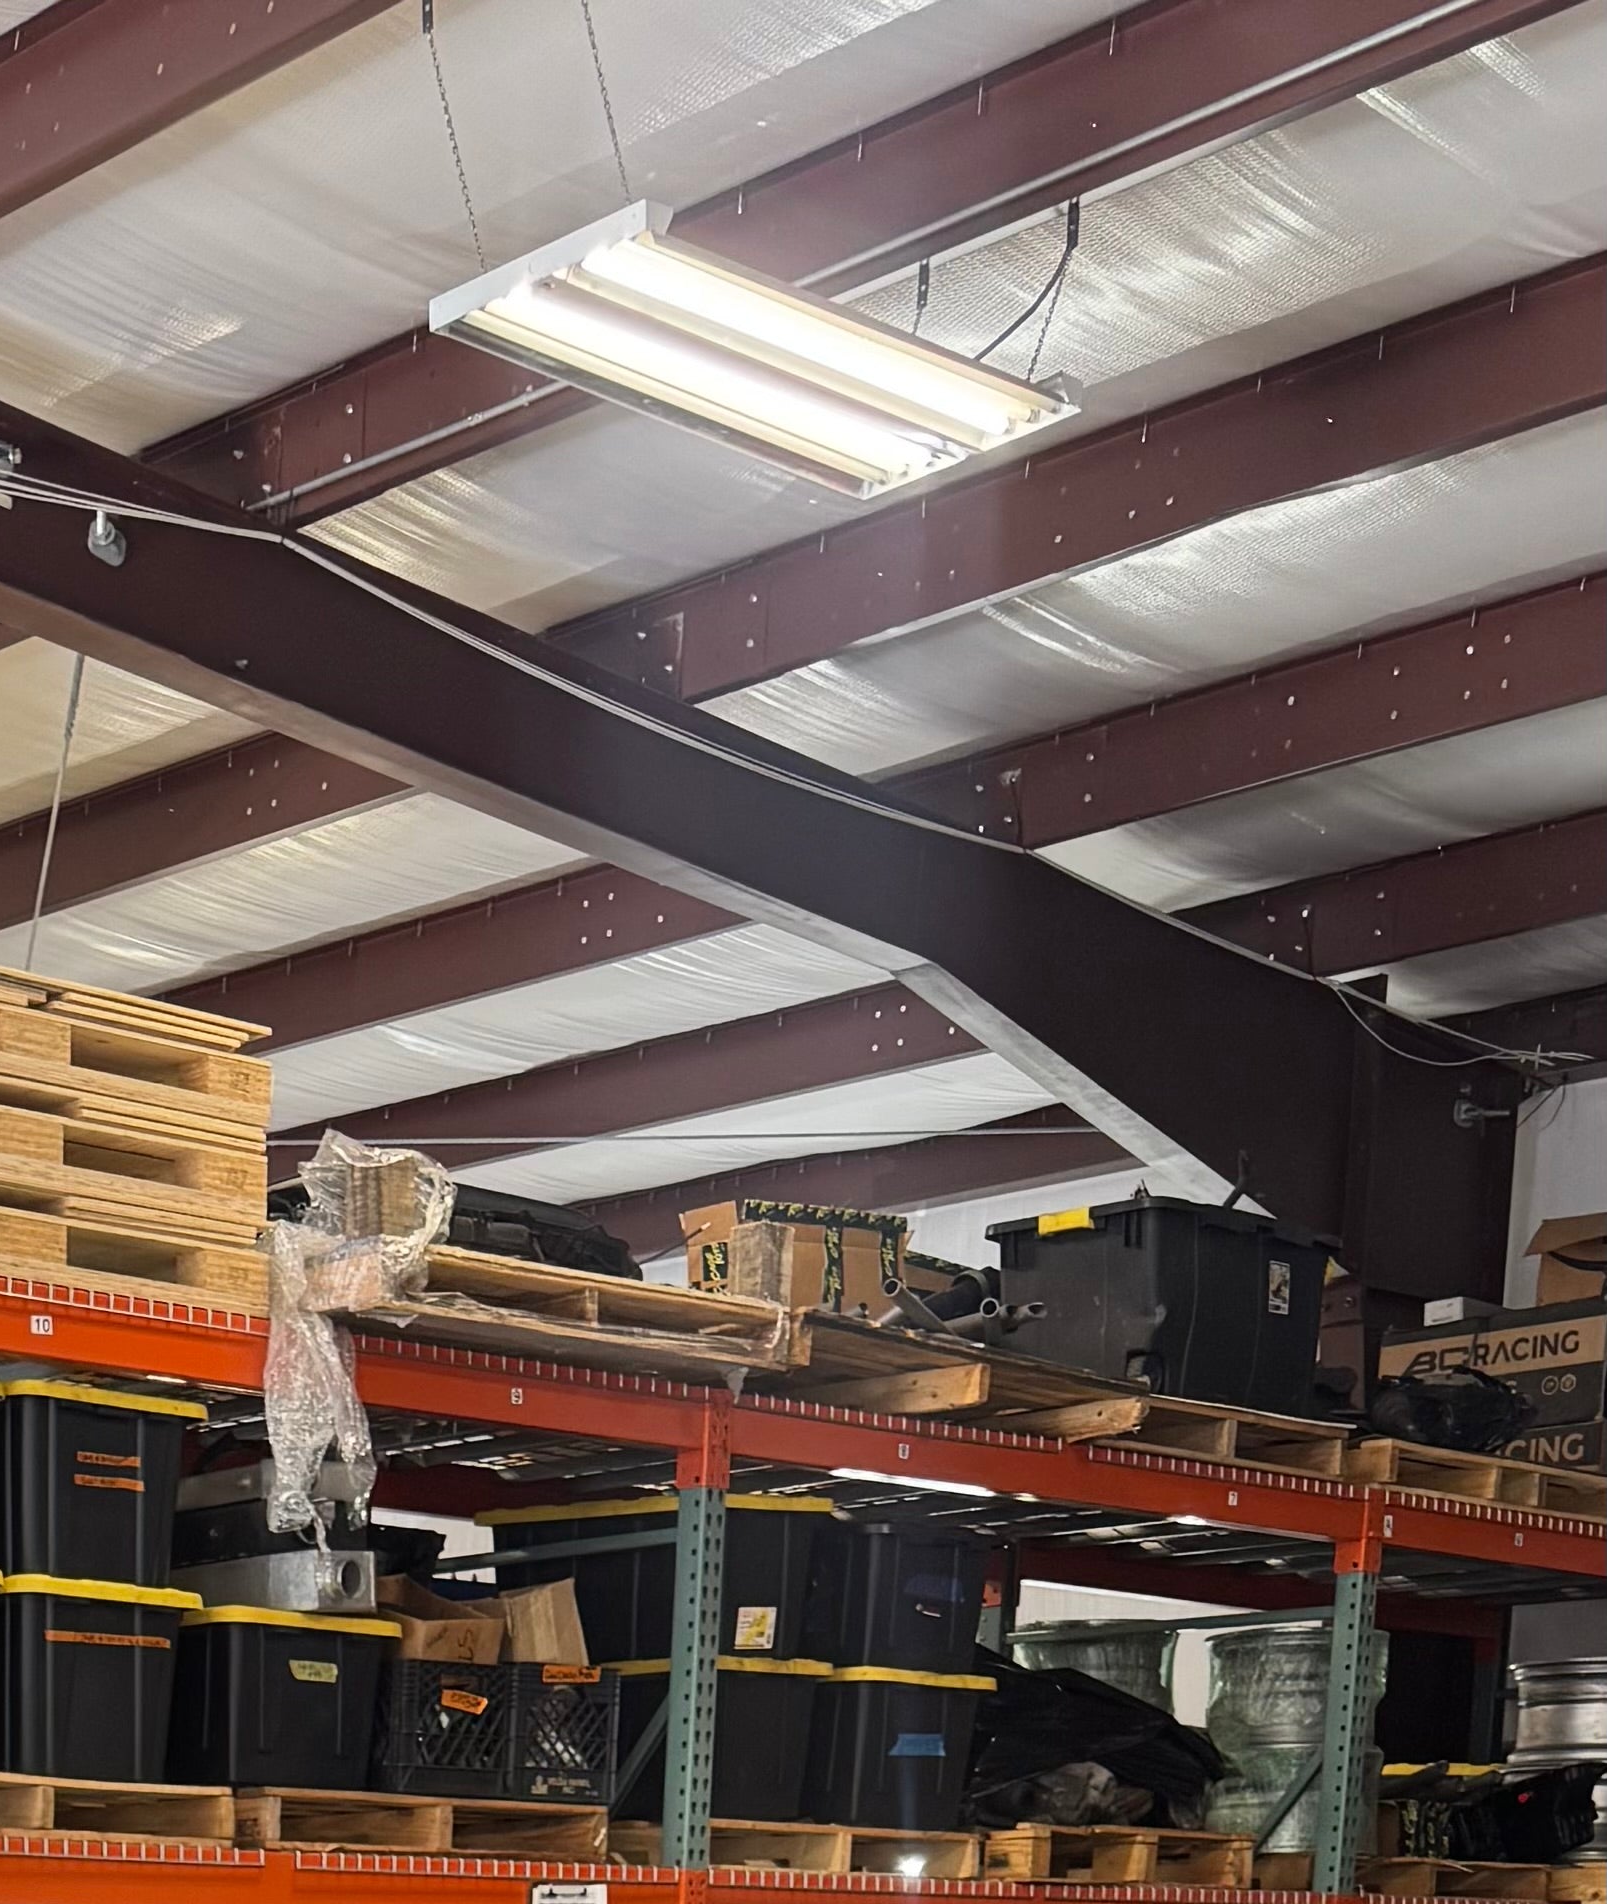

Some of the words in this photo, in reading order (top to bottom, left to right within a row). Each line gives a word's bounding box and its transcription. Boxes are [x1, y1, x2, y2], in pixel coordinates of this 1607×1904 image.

[34, 1317, 51, 1333] 10
[1473, 1330, 1581, 1367] RACING
[1496, 1432, 1585, 1464] CING
